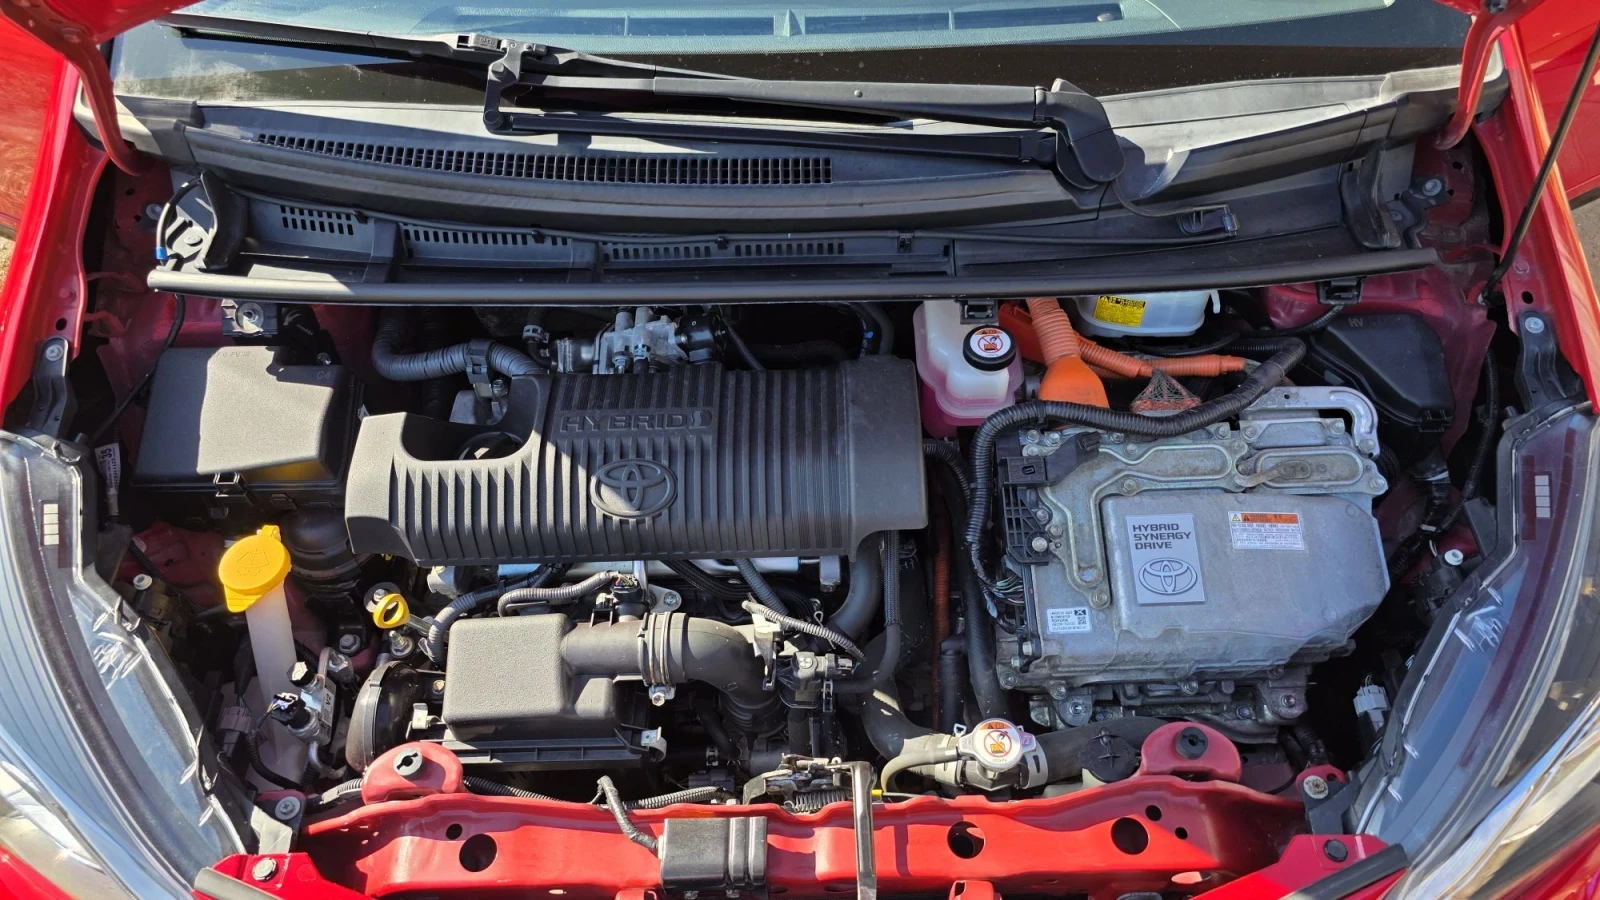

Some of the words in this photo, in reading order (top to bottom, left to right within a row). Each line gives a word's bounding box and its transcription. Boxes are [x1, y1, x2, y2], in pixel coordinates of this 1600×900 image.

[560, 413, 688, 433] HYBRID
[1132, 523, 1180, 532] HYBRID
[1133, 532, 1192, 541] SYNERGY
[1134, 541, 1173, 550] DRIVE
